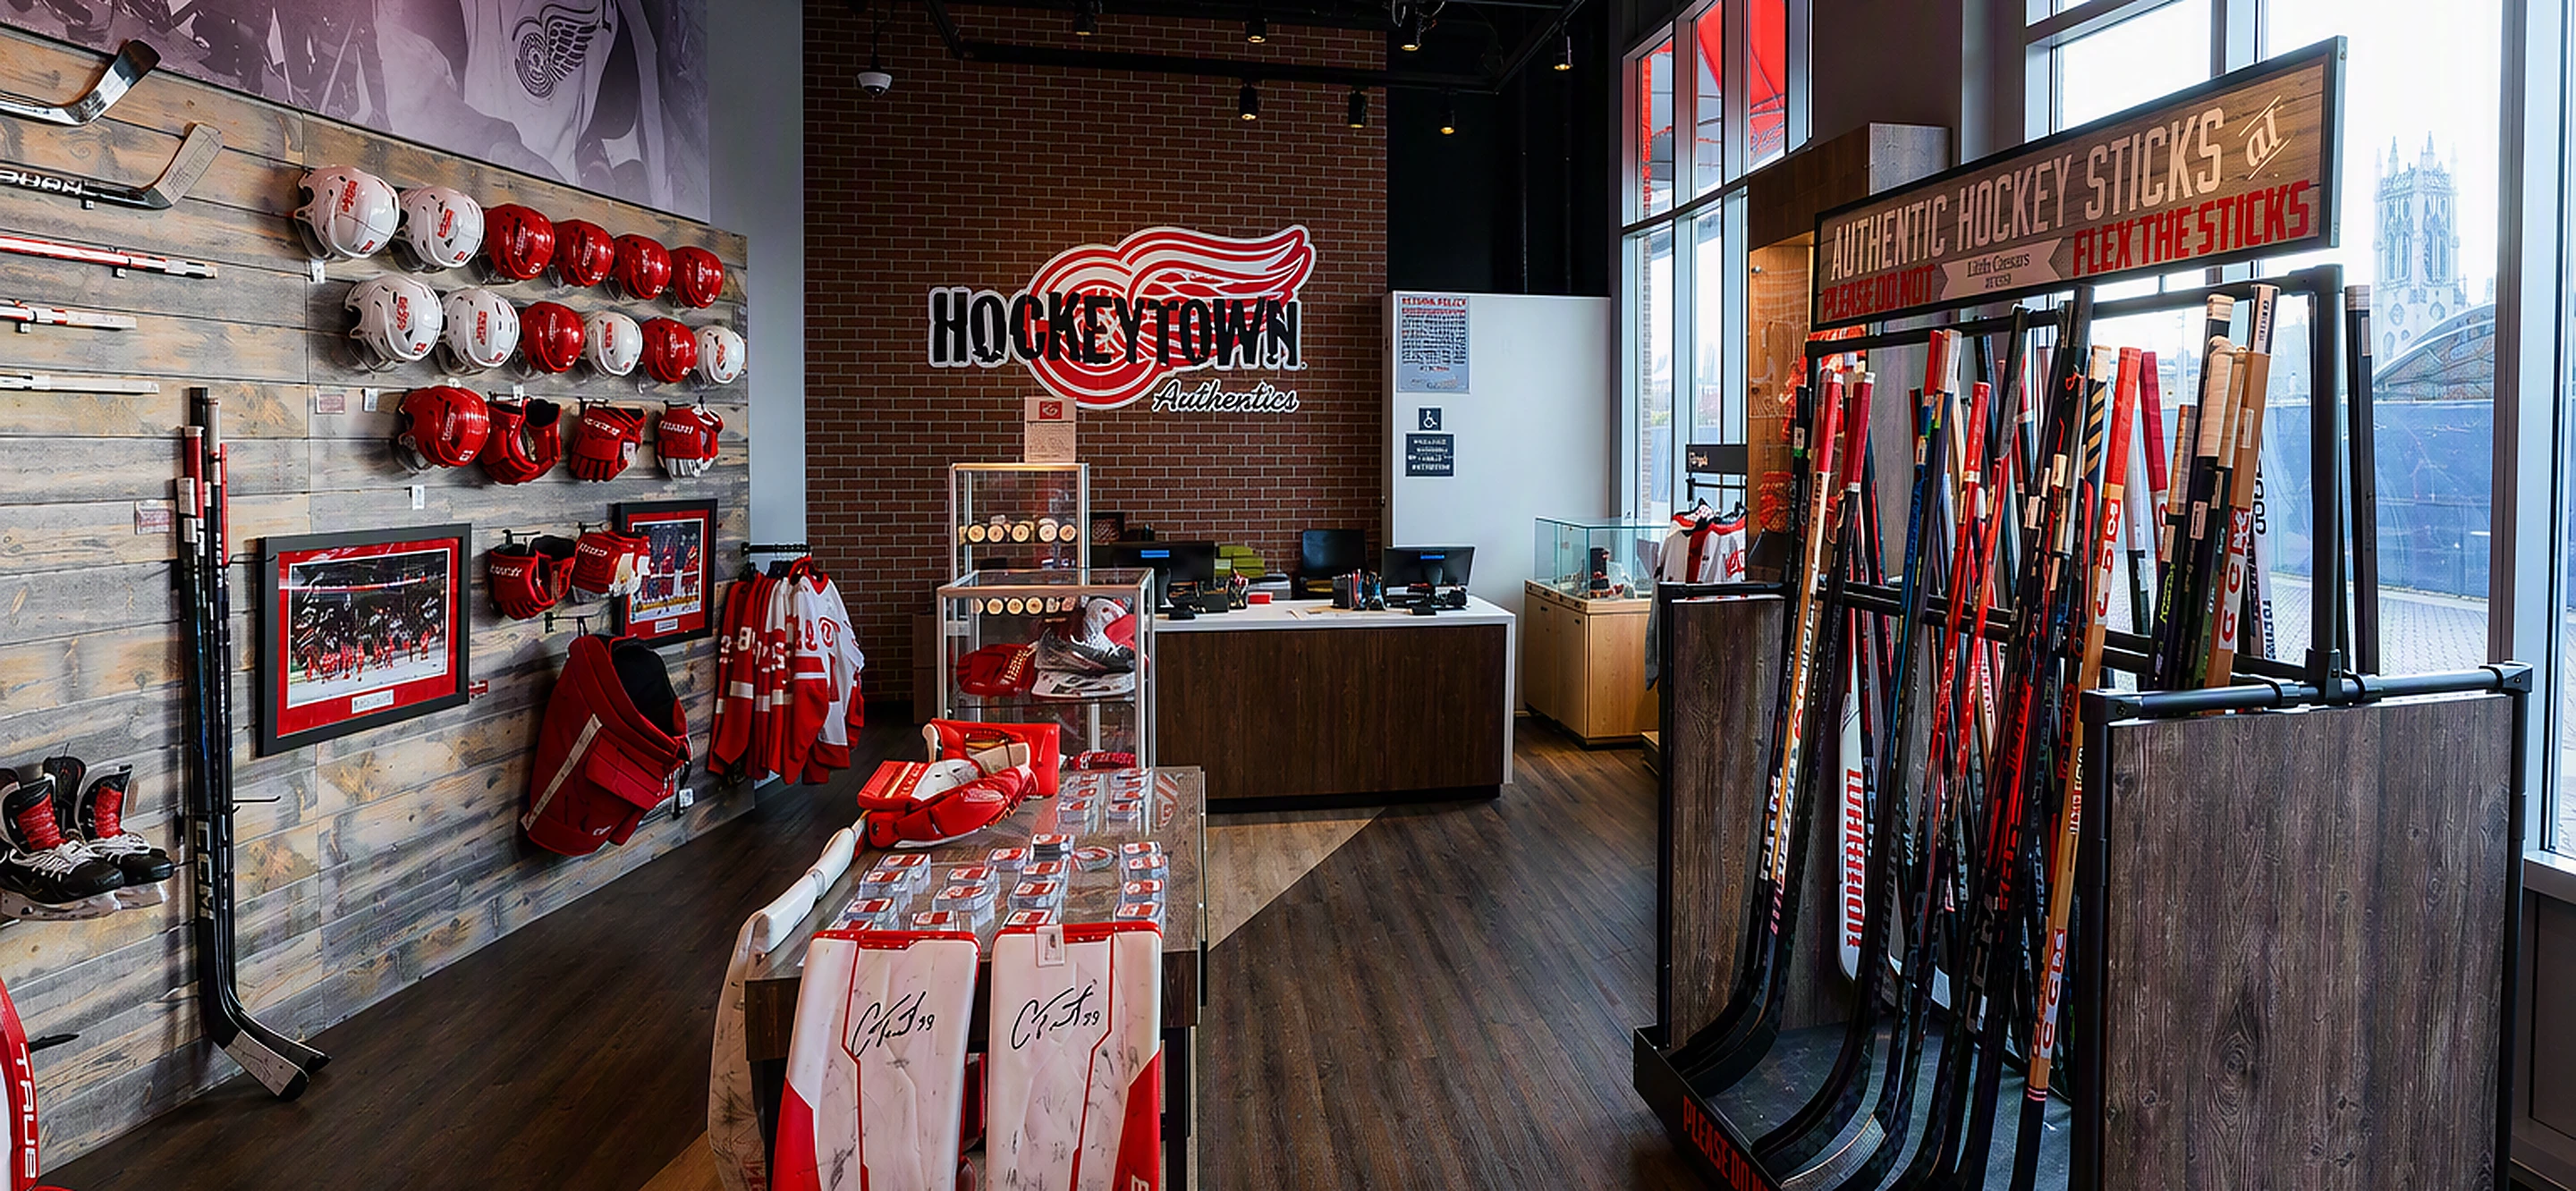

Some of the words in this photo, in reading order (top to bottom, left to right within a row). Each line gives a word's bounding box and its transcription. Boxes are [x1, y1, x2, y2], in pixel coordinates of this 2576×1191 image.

[1830, 193, 1946, 282] AUTHENTIC
[1956, 154, 2072, 253] HOCKEY
[2085, 106, 2224, 222] STICKS
[2072, 219, 2135, 277] FLEX
[2135, 206, 2192, 265] THE
[2196, 179, 2310, 257] STICKS
[931, 290, 1300, 367] HOCKEYTOWN
[1822, 275, 1875, 322] PLEASE
[1877, 270, 1897, 309] DO
[1897, 264, 1937, 306] NOT
[1152, 378, 1300, 413] Authentics
[1682, 1094, 1730, 1179] PLEASE
